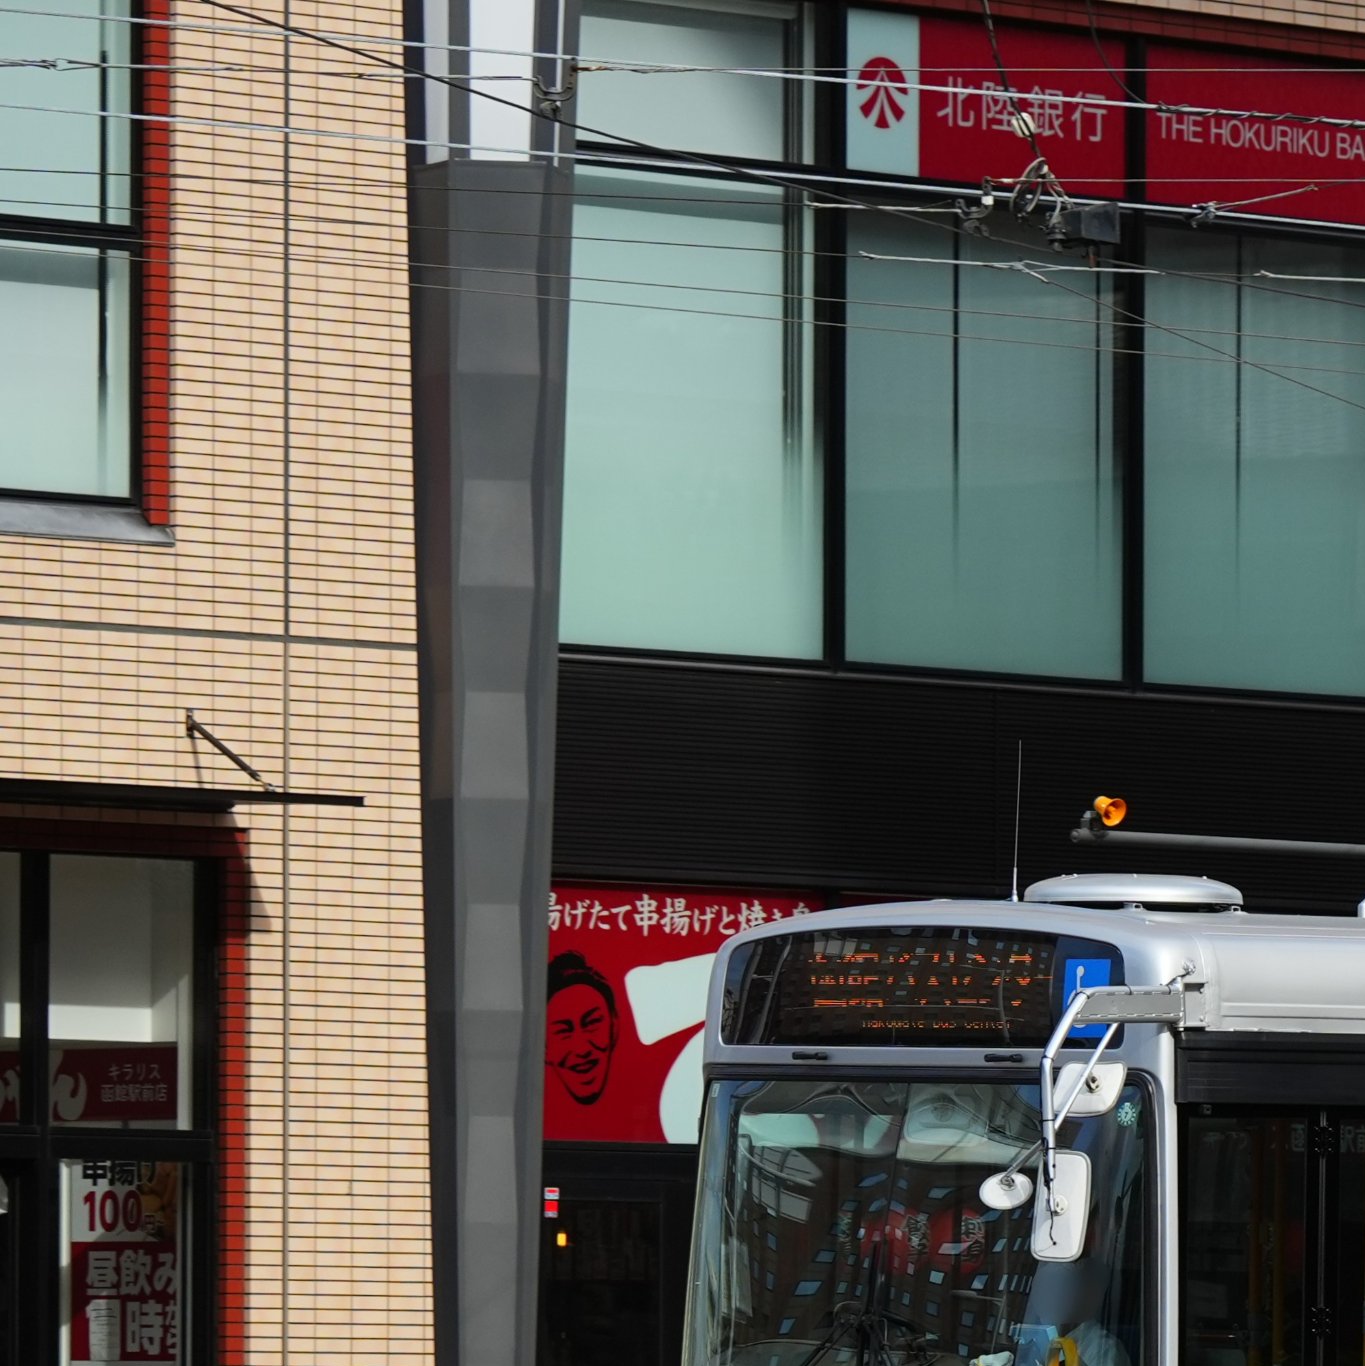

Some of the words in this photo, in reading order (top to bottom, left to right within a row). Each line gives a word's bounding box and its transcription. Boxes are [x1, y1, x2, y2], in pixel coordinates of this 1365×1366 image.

[936, 75, 1108, 142] 北陸銀行
[1156, 111, 1204, 143] THE
[1209, 117, 1330, 158] HOKURIKU
[108, 1063, 161, 1081] キラリス
[101, 1084, 168, 1103] 函館駅前店
